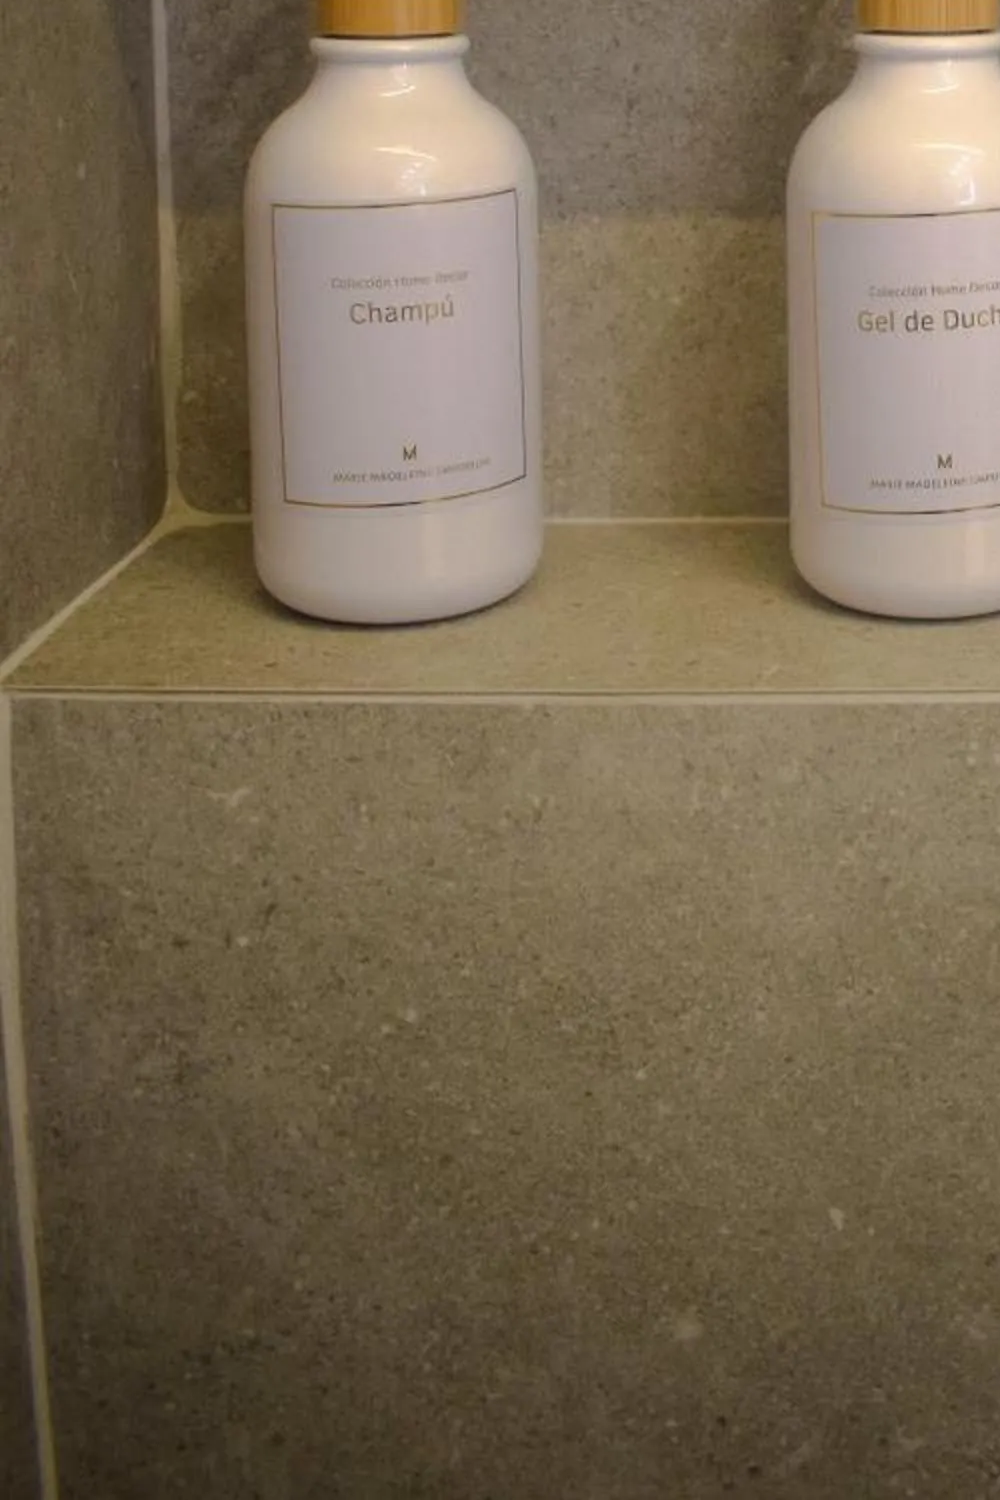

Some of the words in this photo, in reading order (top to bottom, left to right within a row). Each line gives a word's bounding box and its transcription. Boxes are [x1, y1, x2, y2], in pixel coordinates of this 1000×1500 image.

[931, 283, 967, 296] Home
[350, 293, 454, 325] Champú
[858, 309, 895, 332] Gel
[905, 309, 935, 332] de
[402, 445, 417, 461] M
[937, 454, 953, 469] M
